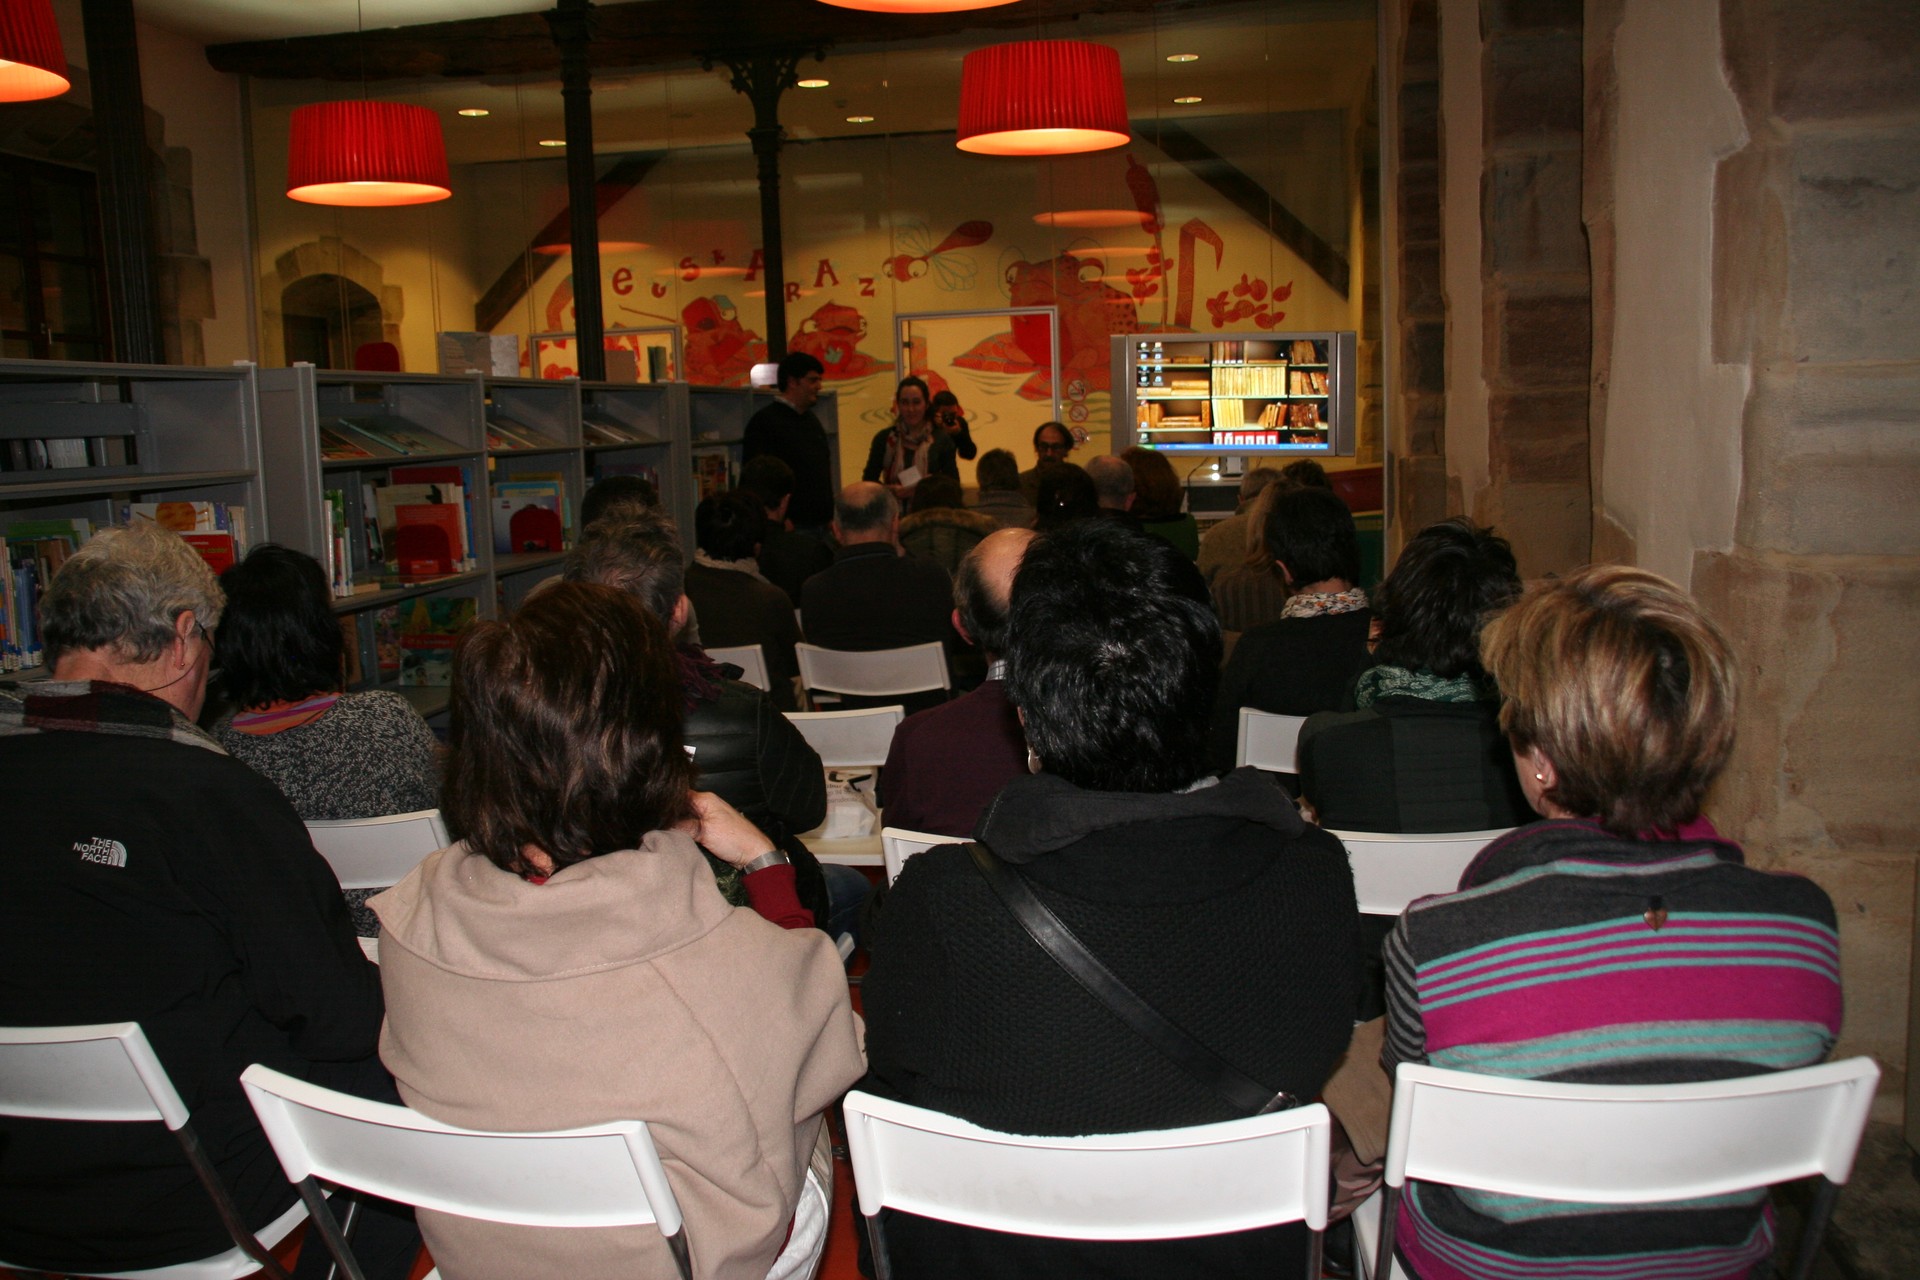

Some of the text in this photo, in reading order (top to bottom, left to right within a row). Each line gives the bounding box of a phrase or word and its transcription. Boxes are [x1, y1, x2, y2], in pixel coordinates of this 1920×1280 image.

[91, 836, 112, 848] THE
[73, 842, 110, 855] NORTH
[80, 852, 109, 864] FACE
